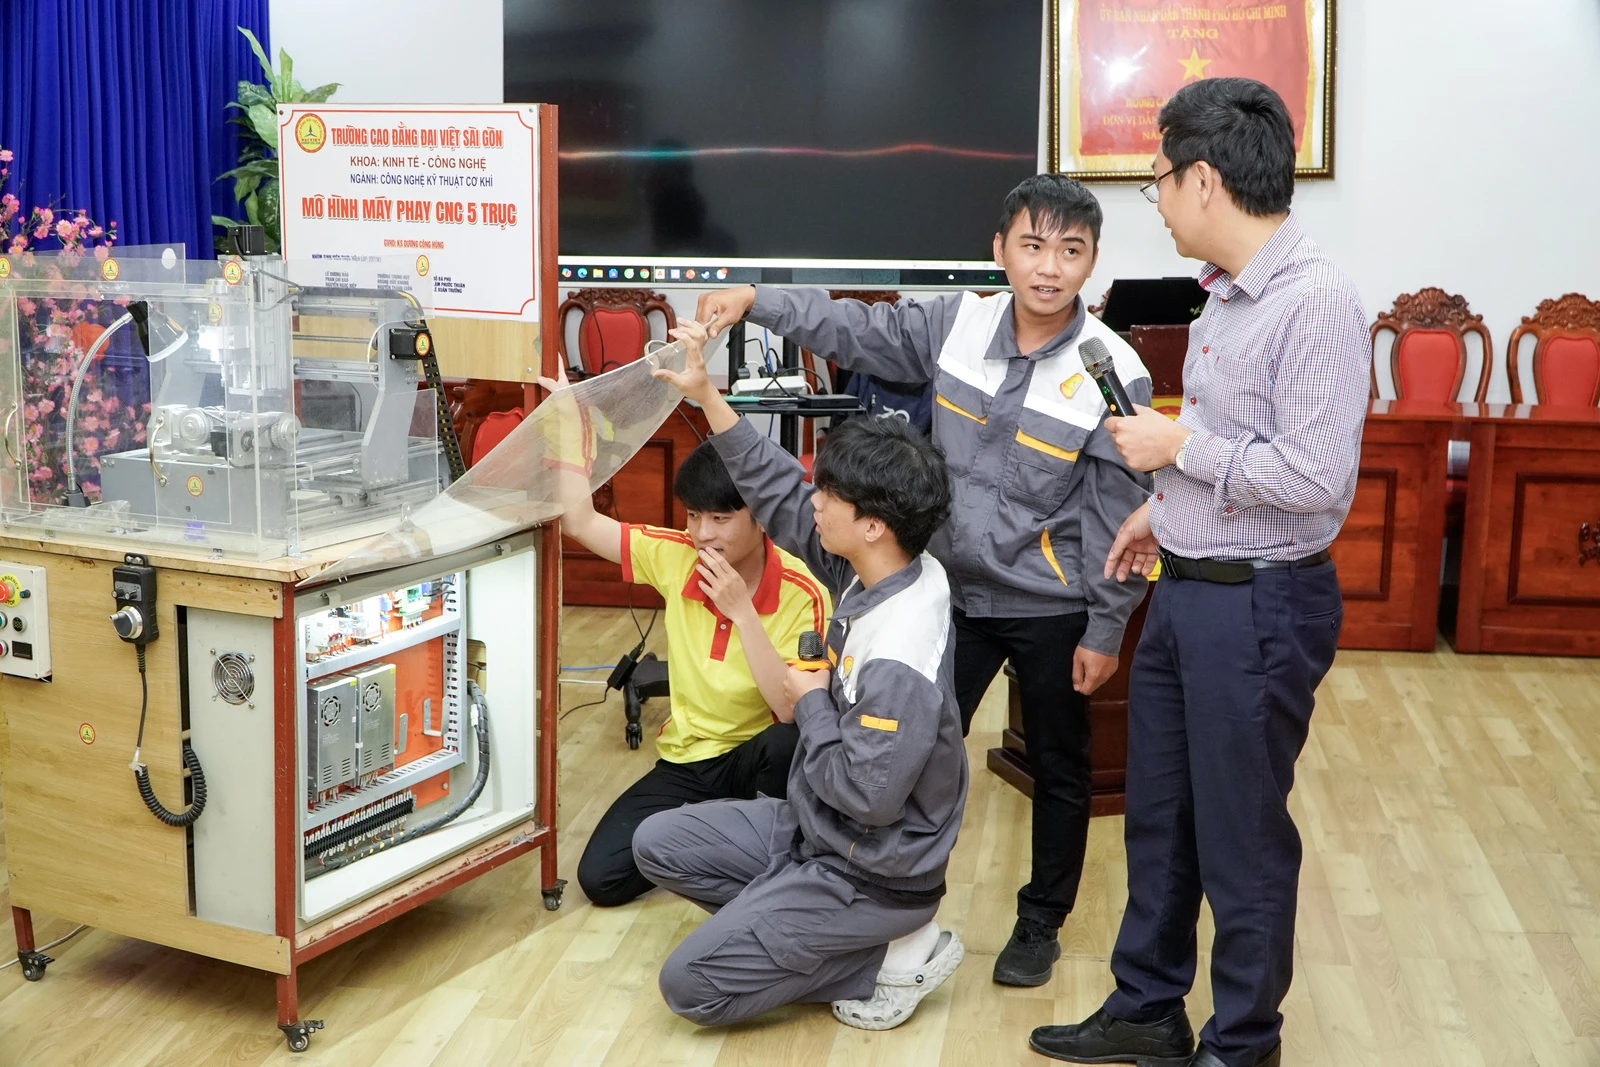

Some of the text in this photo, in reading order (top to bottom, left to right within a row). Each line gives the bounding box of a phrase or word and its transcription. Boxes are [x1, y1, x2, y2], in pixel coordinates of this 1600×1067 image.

[1180, 5, 1211, 21] THÀNH
[1263, 5, 1287, 19] MINH
[1167, 26, 1220, 41] TẶNG
[331, 124, 368, 146] TRƯỜNG
[370, 128, 389, 147] CAO
[391, 121, 419, 147] ĐẲNG
[420, 128, 438, 151] ĐẠI
[440, 126, 461, 151] VIỆT
[462, 126, 480, 147] SÀI
[482, 126, 504, 148] GÒN
[350, 156, 380, 167] KHOA:
[382, 157, 405, 168] KINH
[427, 154, 456, 169] CÔNG
[459, 156, 487, 172] NGHỆ
[350, 171, 494, 189] NGÀNH: CÔNG NGHỆ KỸ THUẬT CƠ KHÍ
[301, 193, 518, 230] MÔ HÌNH MÁY PHAY CNC 5 TRỤC
